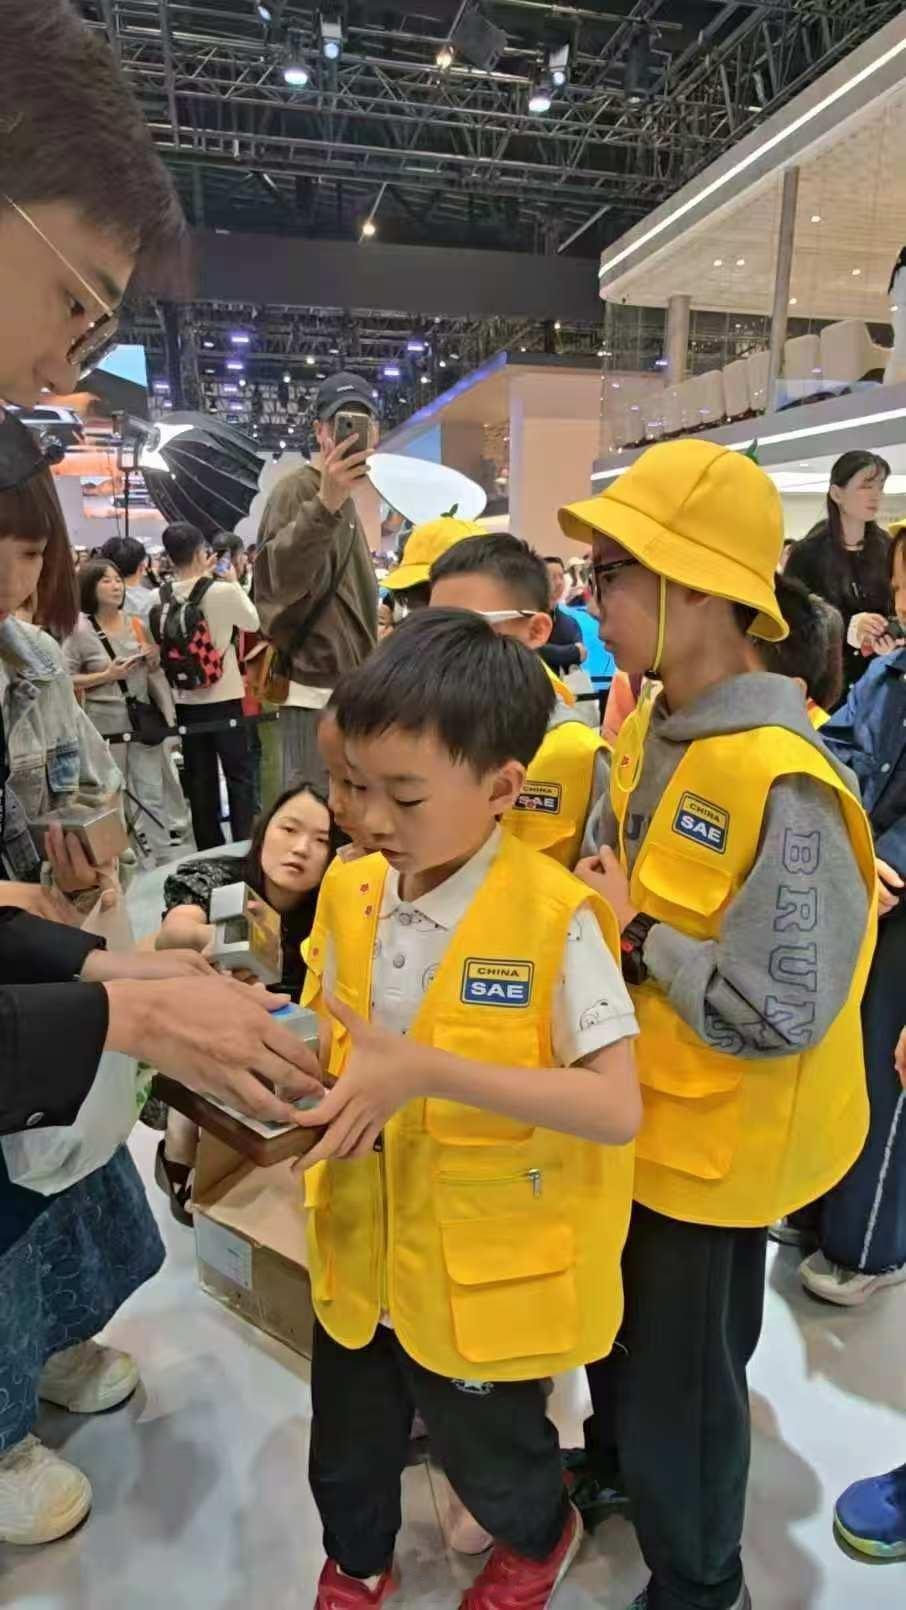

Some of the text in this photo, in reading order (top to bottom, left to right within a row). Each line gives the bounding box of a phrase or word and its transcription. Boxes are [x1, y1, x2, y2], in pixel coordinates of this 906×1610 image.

[690, 803, 720, 823] CHINA
[680, 815, 721, 843] SAE
[477, 967, 520, 977] CHINA
[471, 982, 524, 999] SAE
